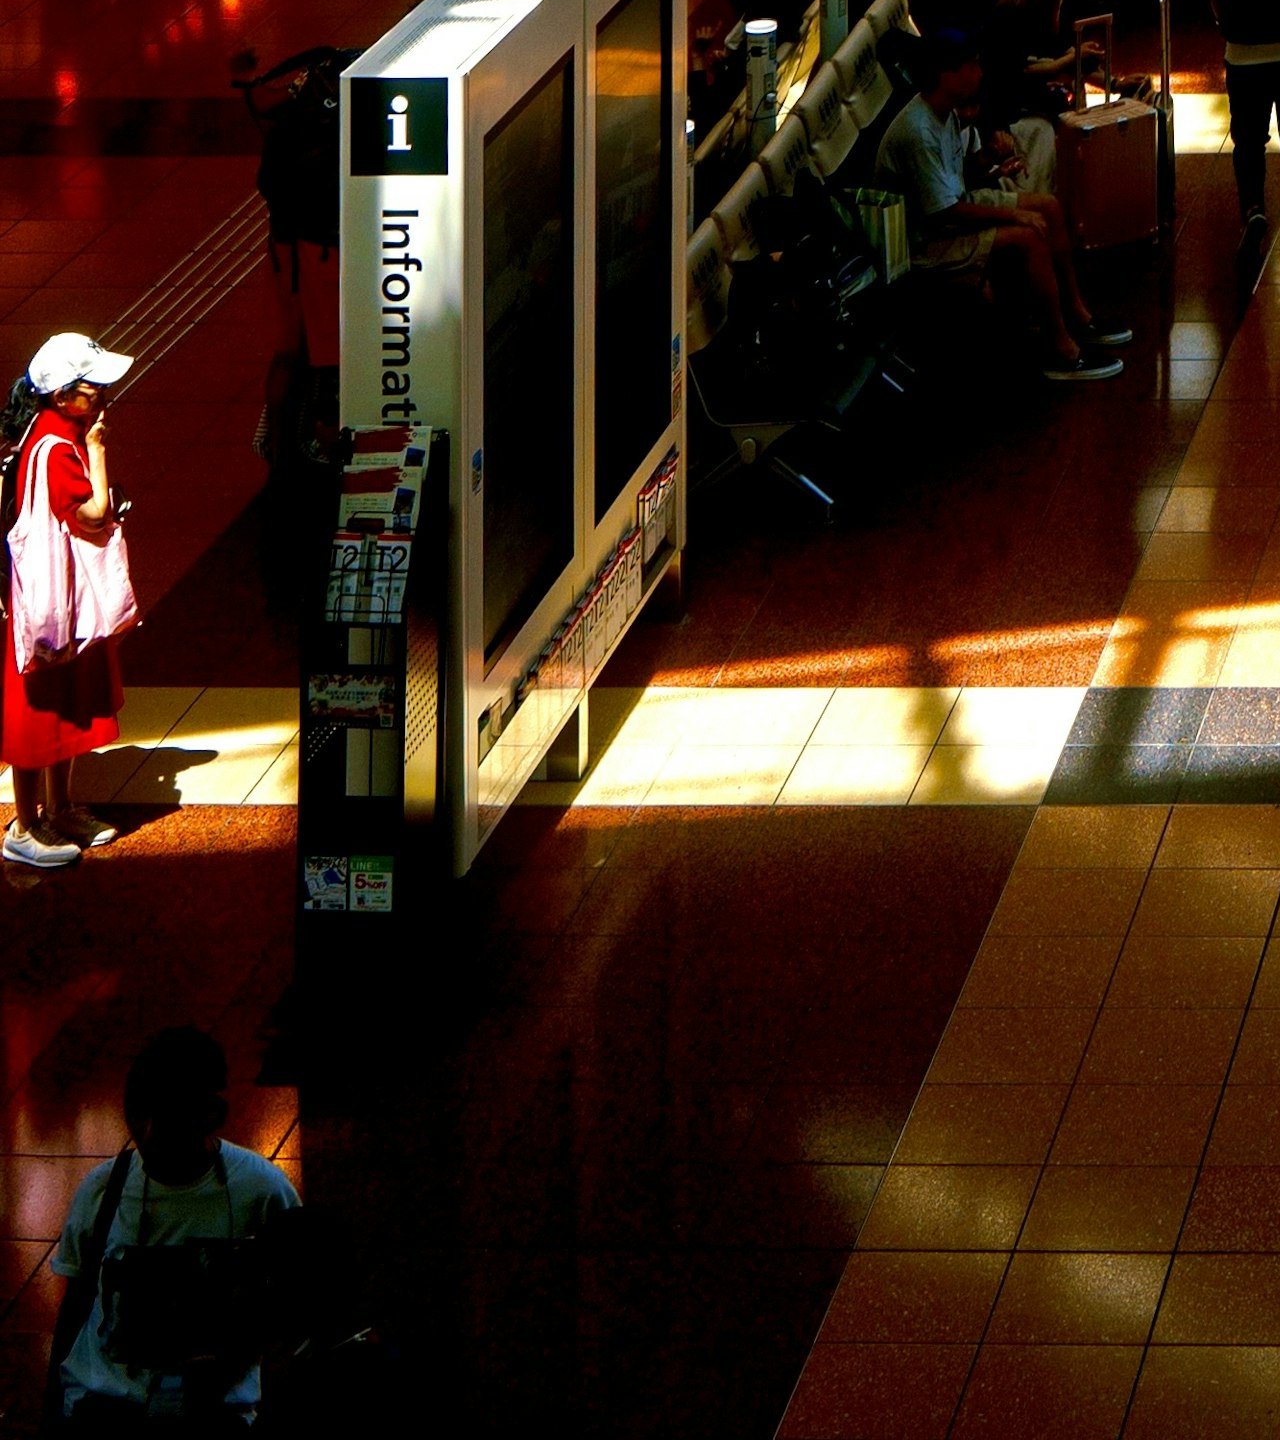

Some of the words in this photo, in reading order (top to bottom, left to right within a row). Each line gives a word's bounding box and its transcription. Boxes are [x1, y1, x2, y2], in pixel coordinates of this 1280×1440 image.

[386, 94, 412, 152] i
[381, 209, 424, 427] Informati
[333, 544, 359, 570] T2
[376, 544, 408, 571] T2
[350, 861, 372, 871] LINE
